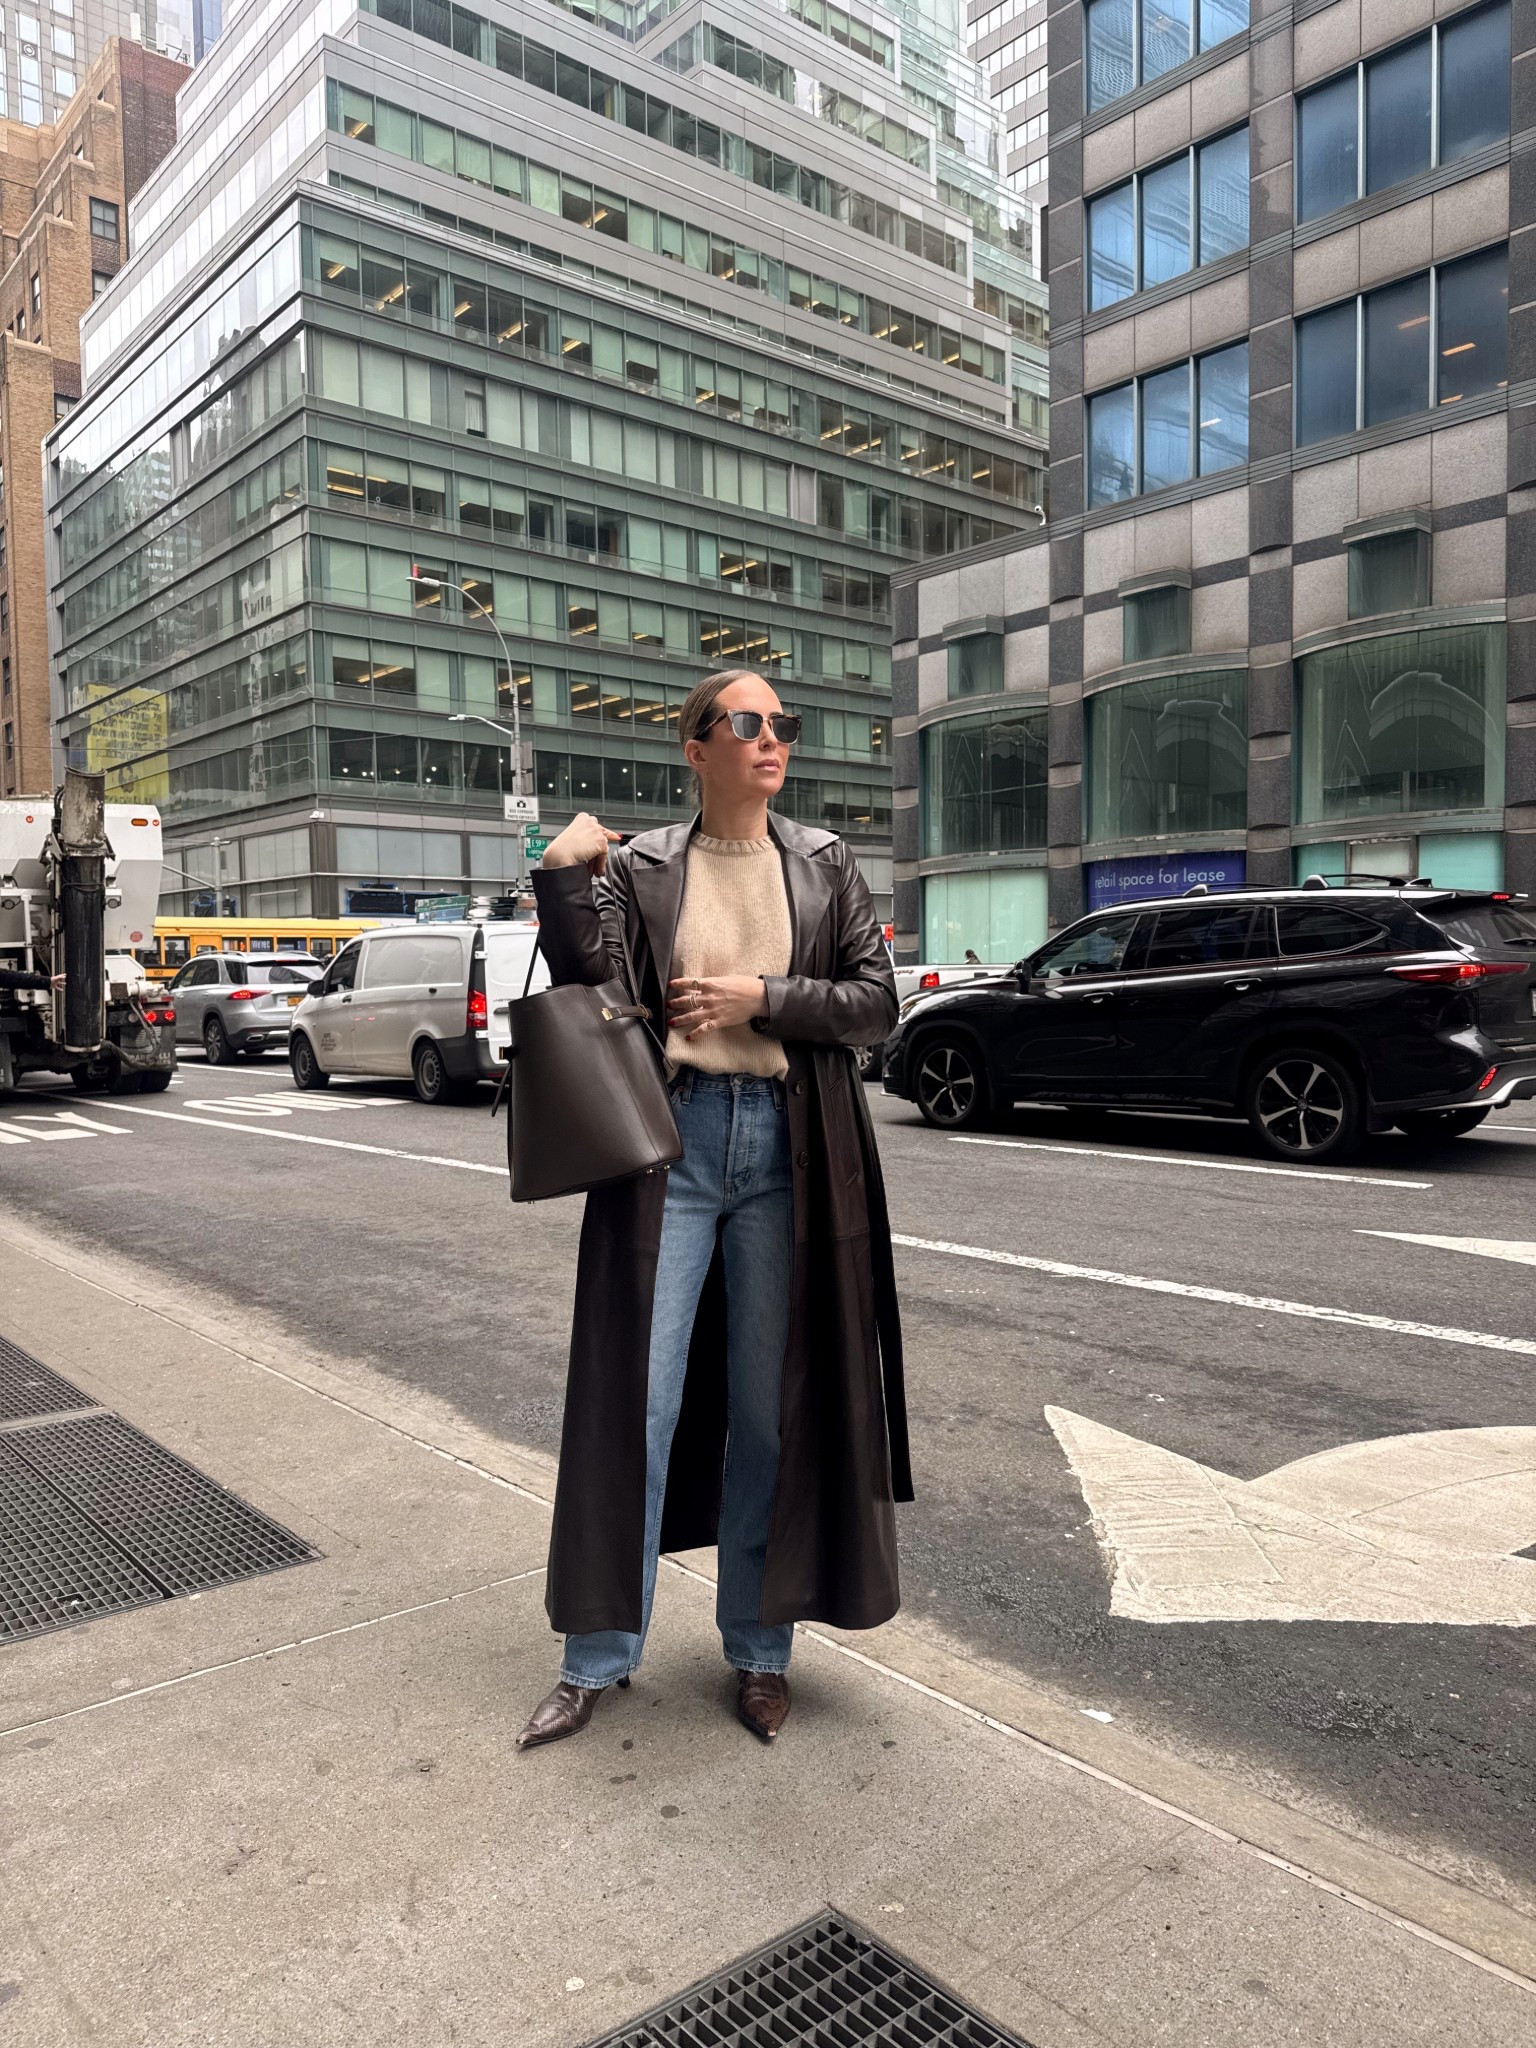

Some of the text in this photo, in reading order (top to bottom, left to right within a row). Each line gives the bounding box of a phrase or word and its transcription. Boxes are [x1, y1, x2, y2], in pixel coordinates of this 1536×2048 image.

[535, 840, 542, 848] 59
[1118, 874, 1154, 890] space
[1158, 868, 1179, 883] for
[1183, 867, 1225, 882] lease
